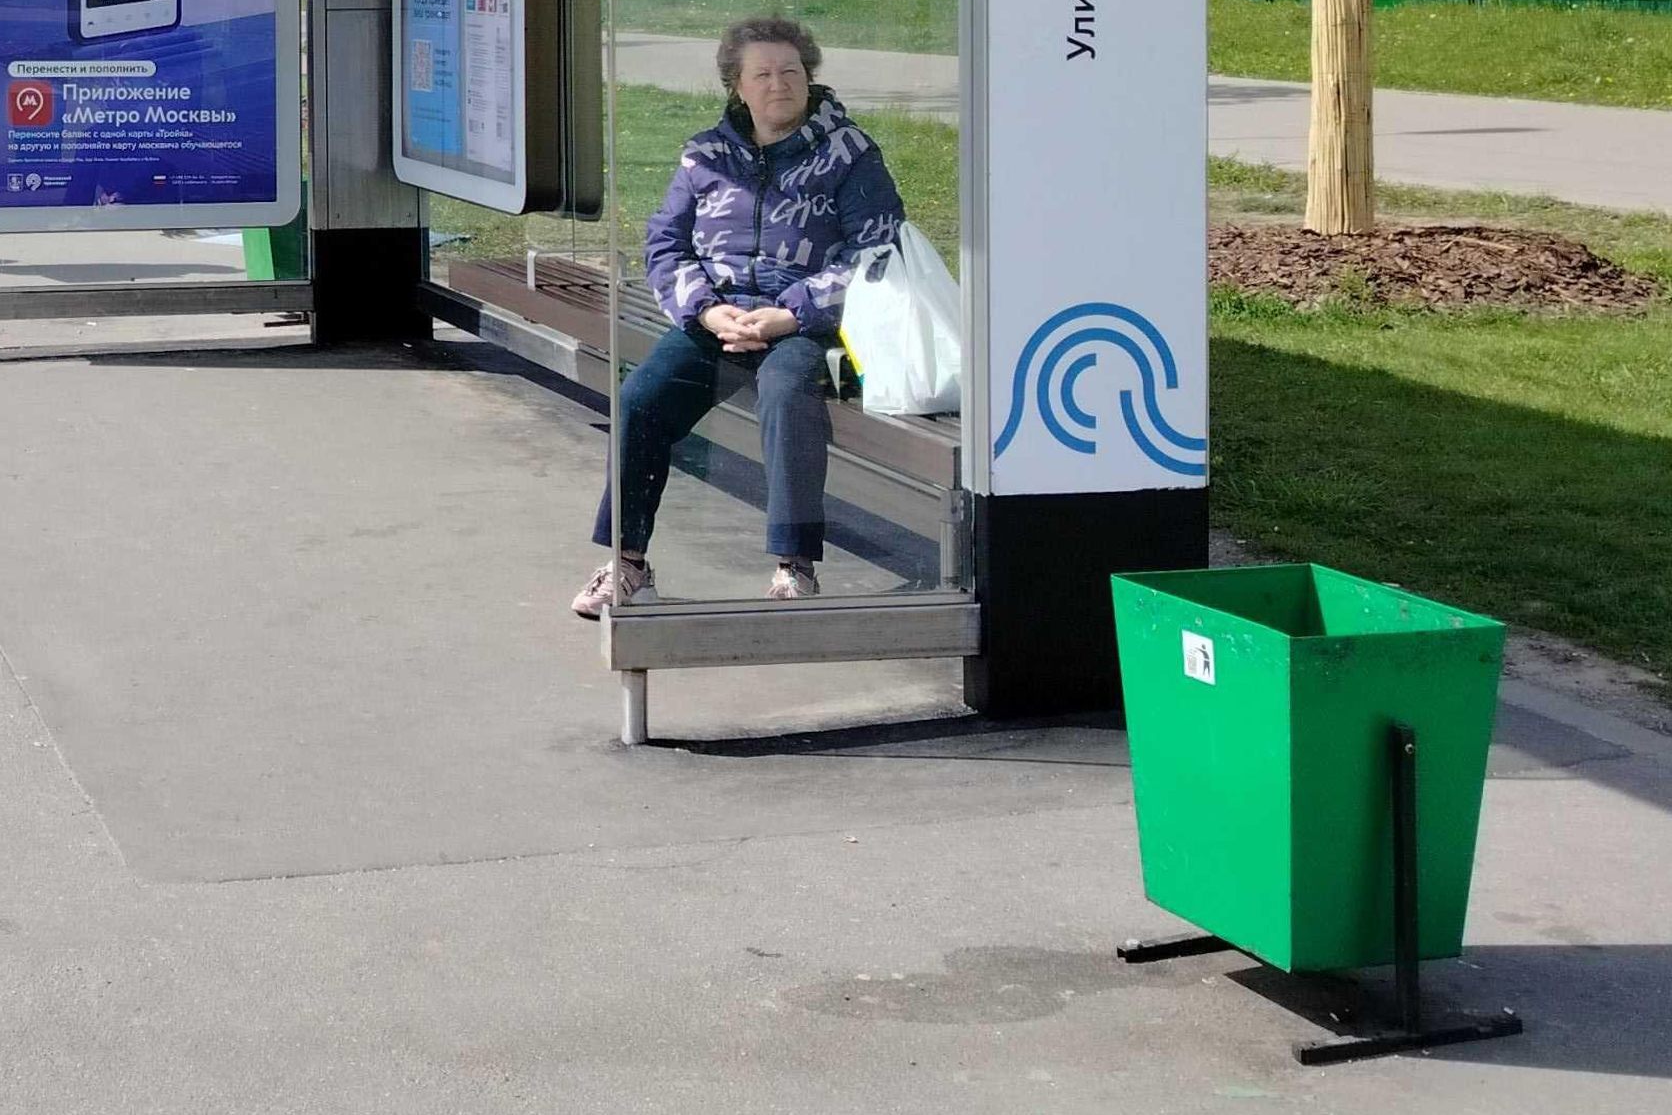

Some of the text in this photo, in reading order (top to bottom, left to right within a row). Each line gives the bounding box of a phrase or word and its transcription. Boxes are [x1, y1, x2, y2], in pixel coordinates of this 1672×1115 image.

[17, 64, 77, 74] Перенести
[89, 65, 148, 74] пополнить
[63, 84, 191, 103] Приложение
[62, 106, 236, 127] «Метро Москвы»
[8, 130, 60, 139] Переносите
[61, 129, 91, 139] баланс
[100, 129, 126, 139] одной
[128, 131, 154, 139] карты
[20, 143, 51, 152] другую
[61, 142, 111, 150] пополняйте
[112, 143, 137, 151] карту
